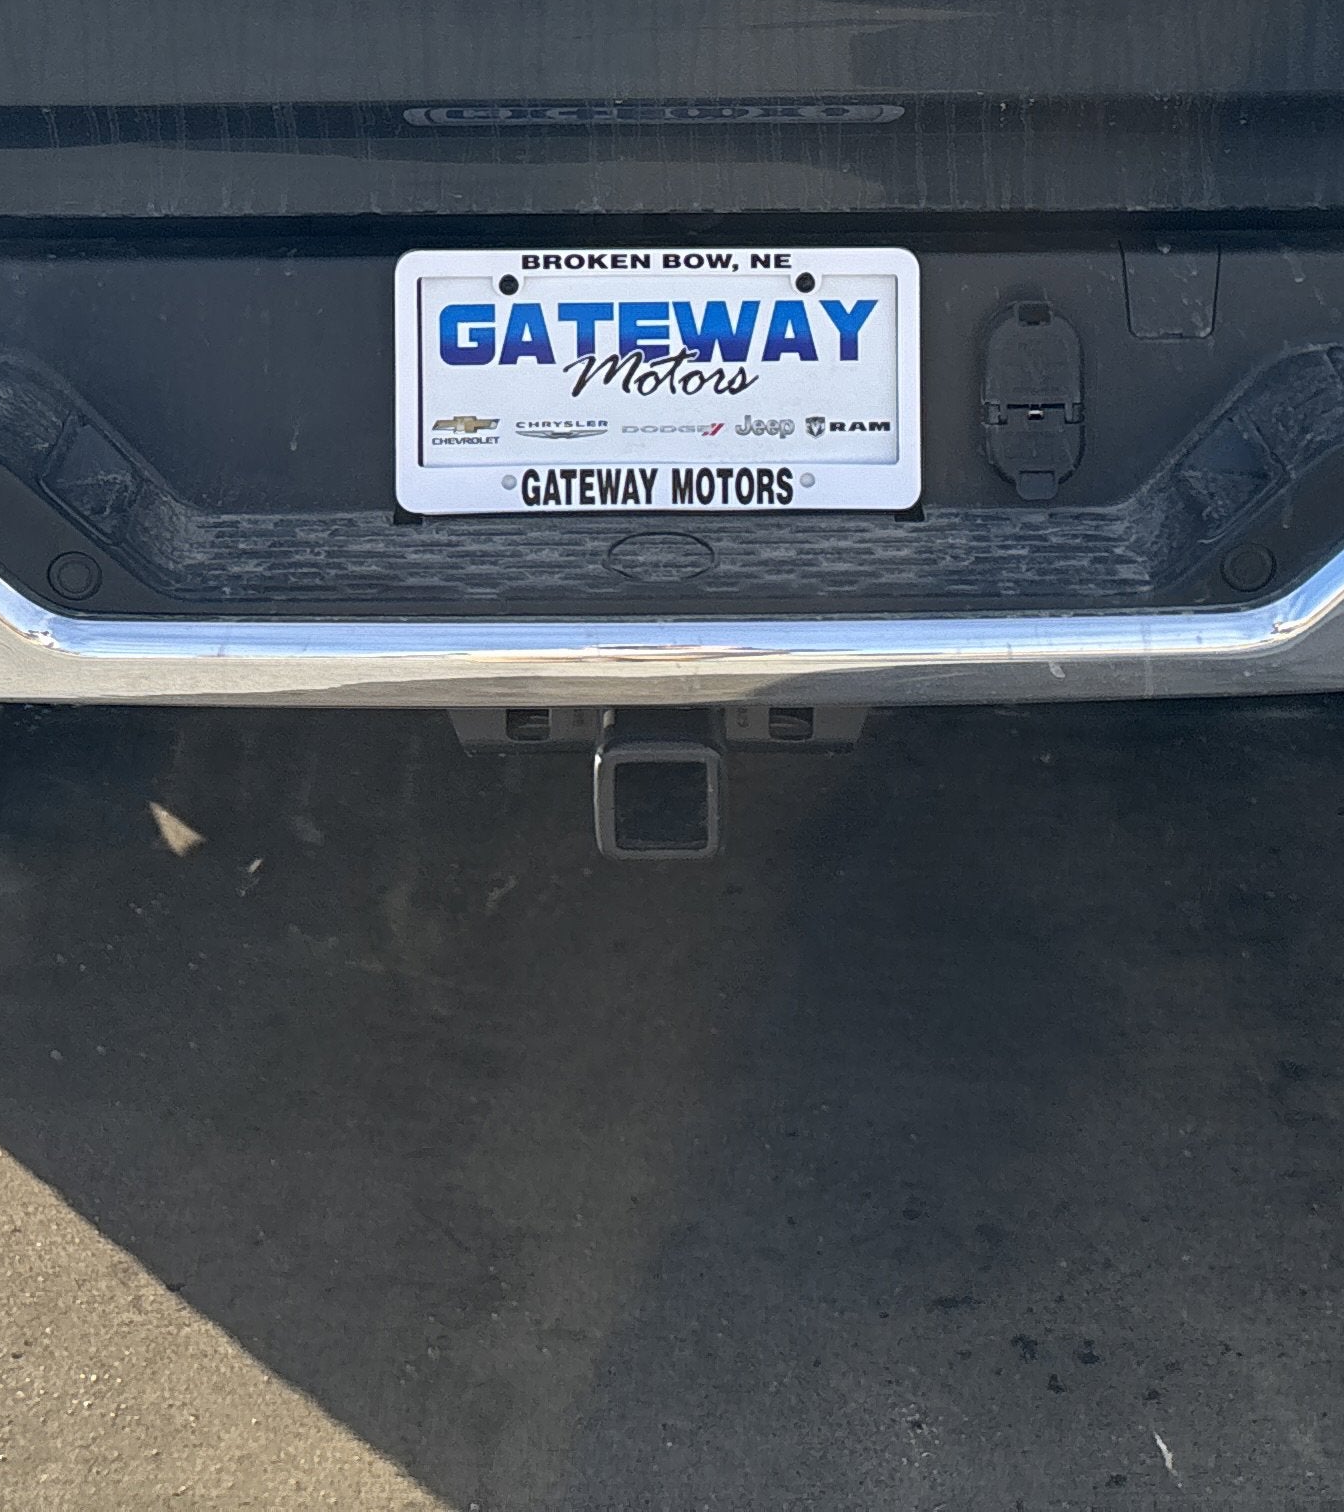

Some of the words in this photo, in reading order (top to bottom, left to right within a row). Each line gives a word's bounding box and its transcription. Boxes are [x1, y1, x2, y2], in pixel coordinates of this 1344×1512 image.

[522, 253, 650, 271] BROKEN
[662, 253, 739, 272] BOW,
[750, 253, 792, 269] NE
[439, 299, 878, 366] GATEWAY
[563, 348, 760, 398] Motors
[515, 419, 608, 428] CHRYSLER
[621, 424, 711, 434] DODGE
[735, 414, 796, 439] Jeep
[829, 421, 892, 432] RAM
[432, 436, 500, 446] CHEVROLET
[521, 468, 659, 506] GATEWAY
[671, 467, 794, 506] MOTORS
